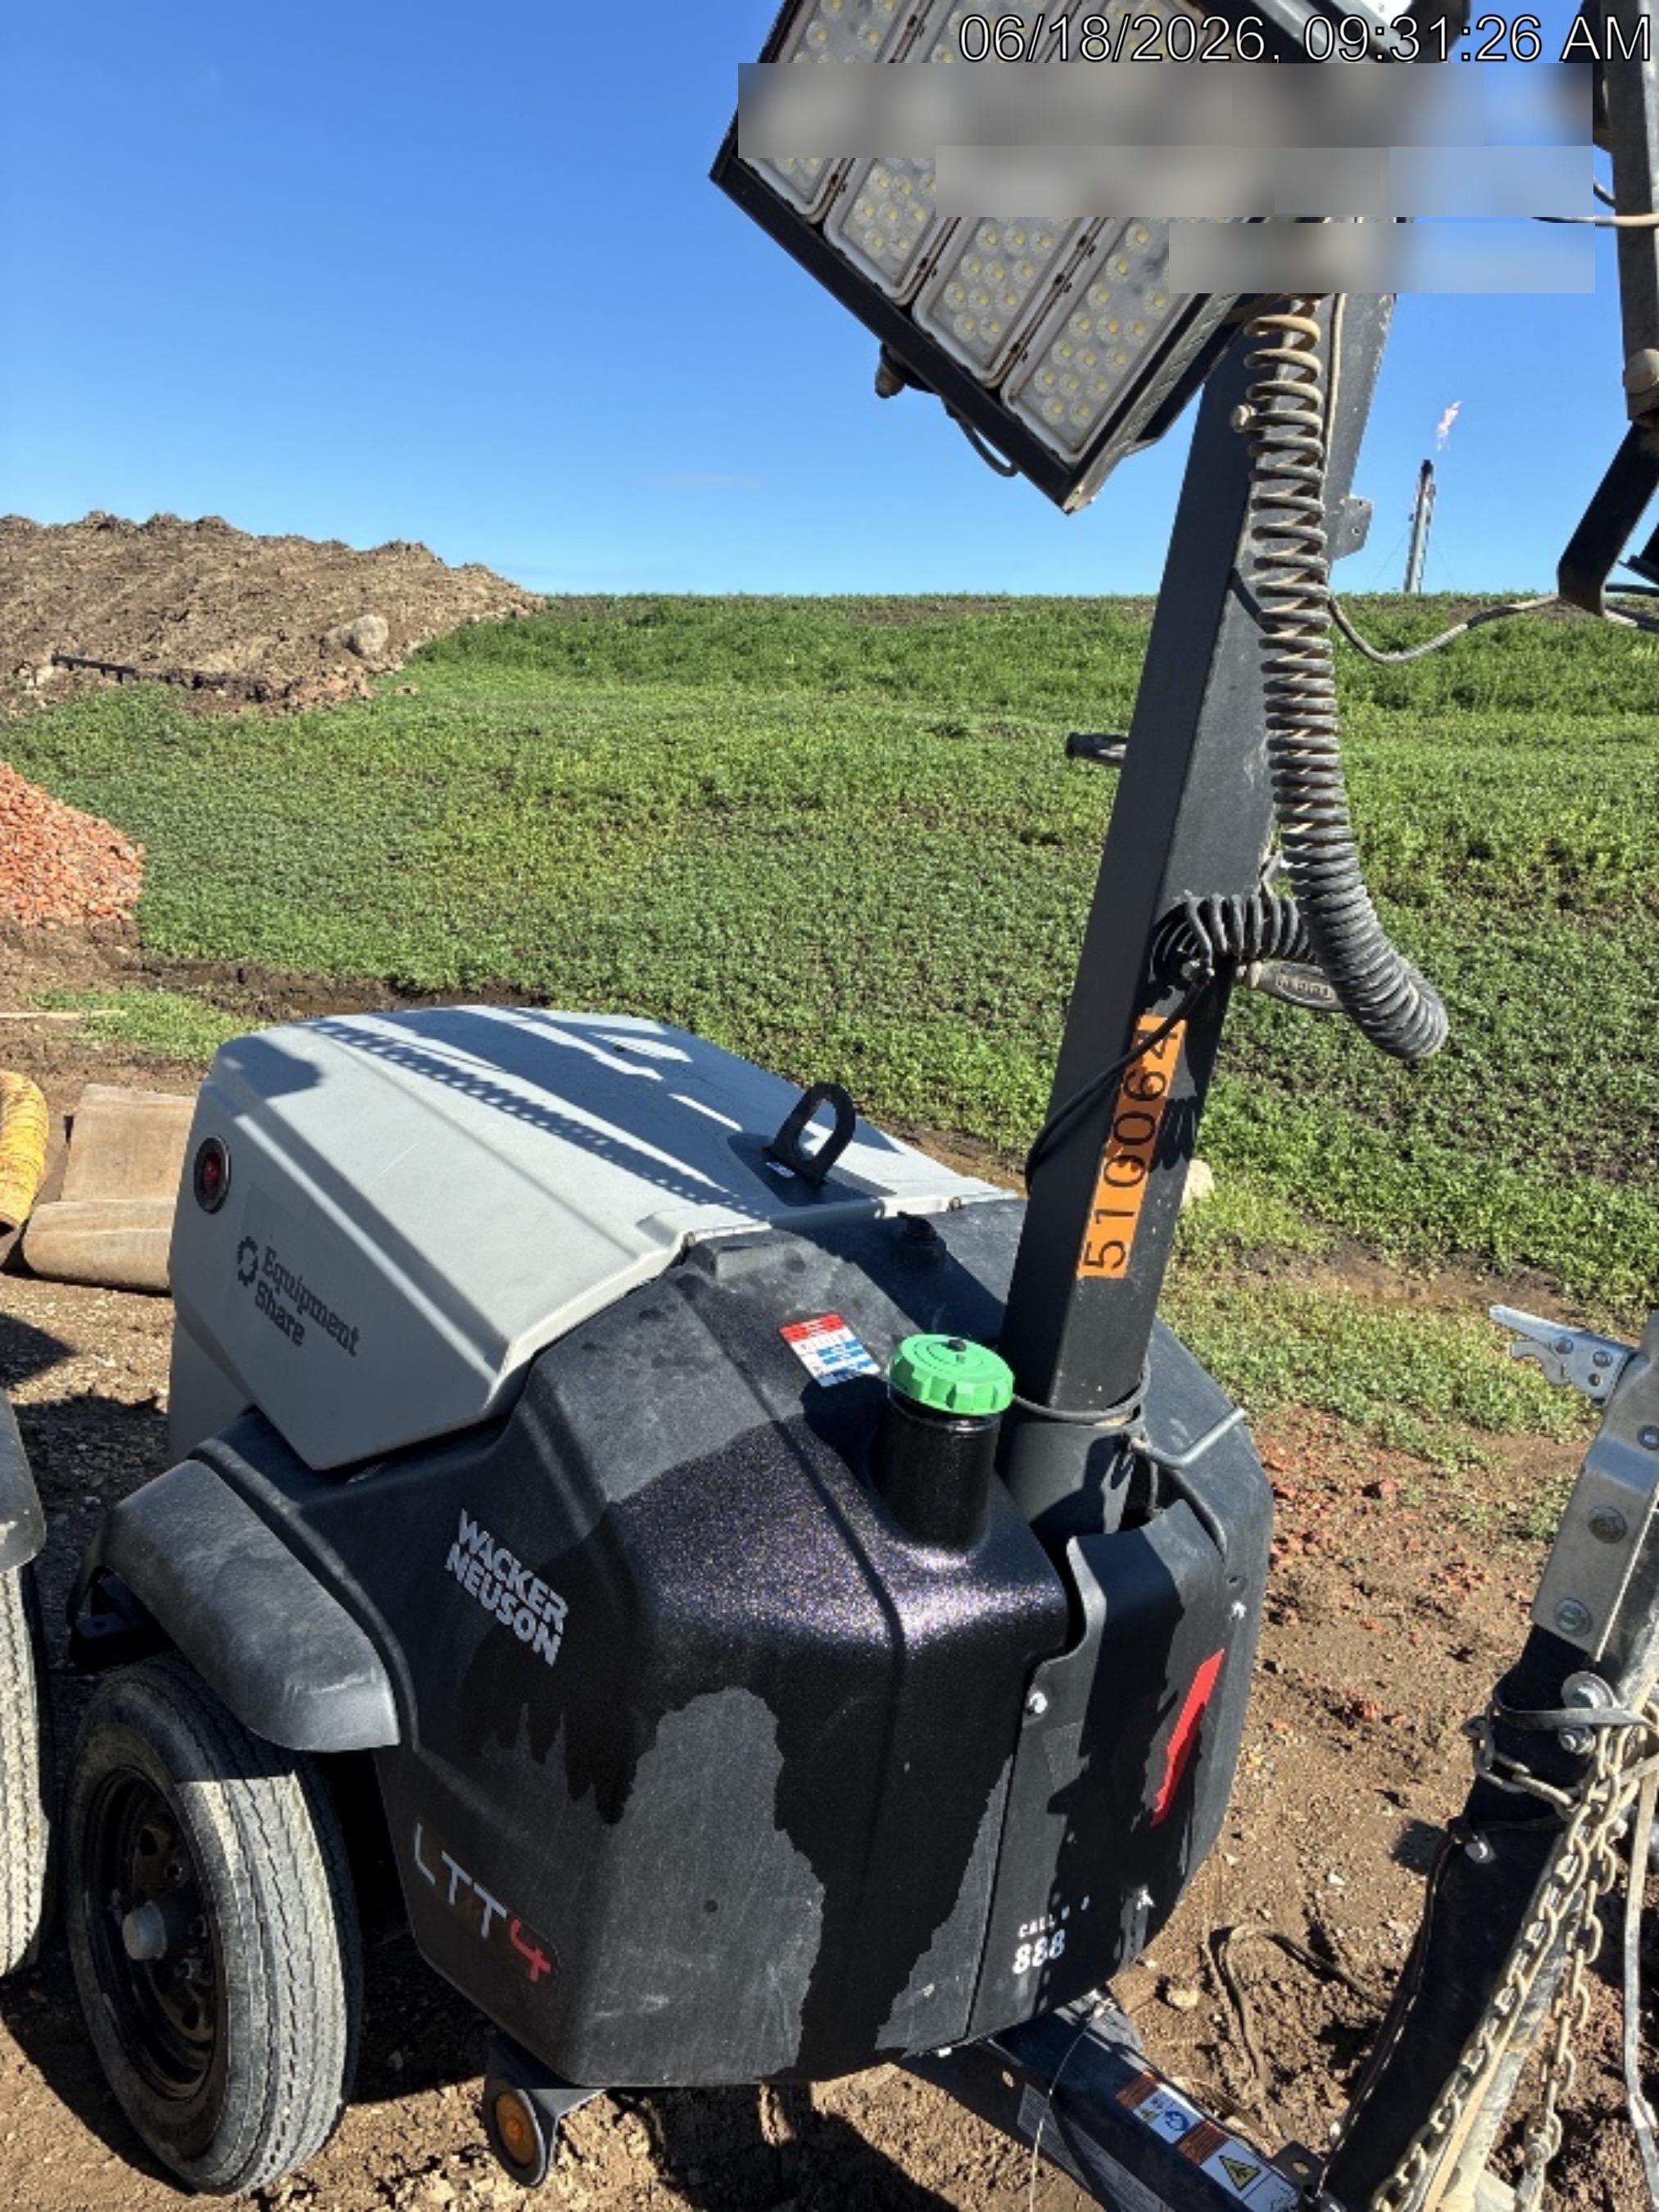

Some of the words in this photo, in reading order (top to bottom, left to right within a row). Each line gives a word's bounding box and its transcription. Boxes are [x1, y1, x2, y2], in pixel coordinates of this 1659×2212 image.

[1083, 1029, 1178, 1270] 510064
[255, 1280, 306, 1348] Share
[262, 1245, 360, 1357] Equipment
[445, 1542, 562, 1667] NEUSON
[458, 1507, 569, 1635] WACKER
[414, 1822, 551, 1982] LTT4
